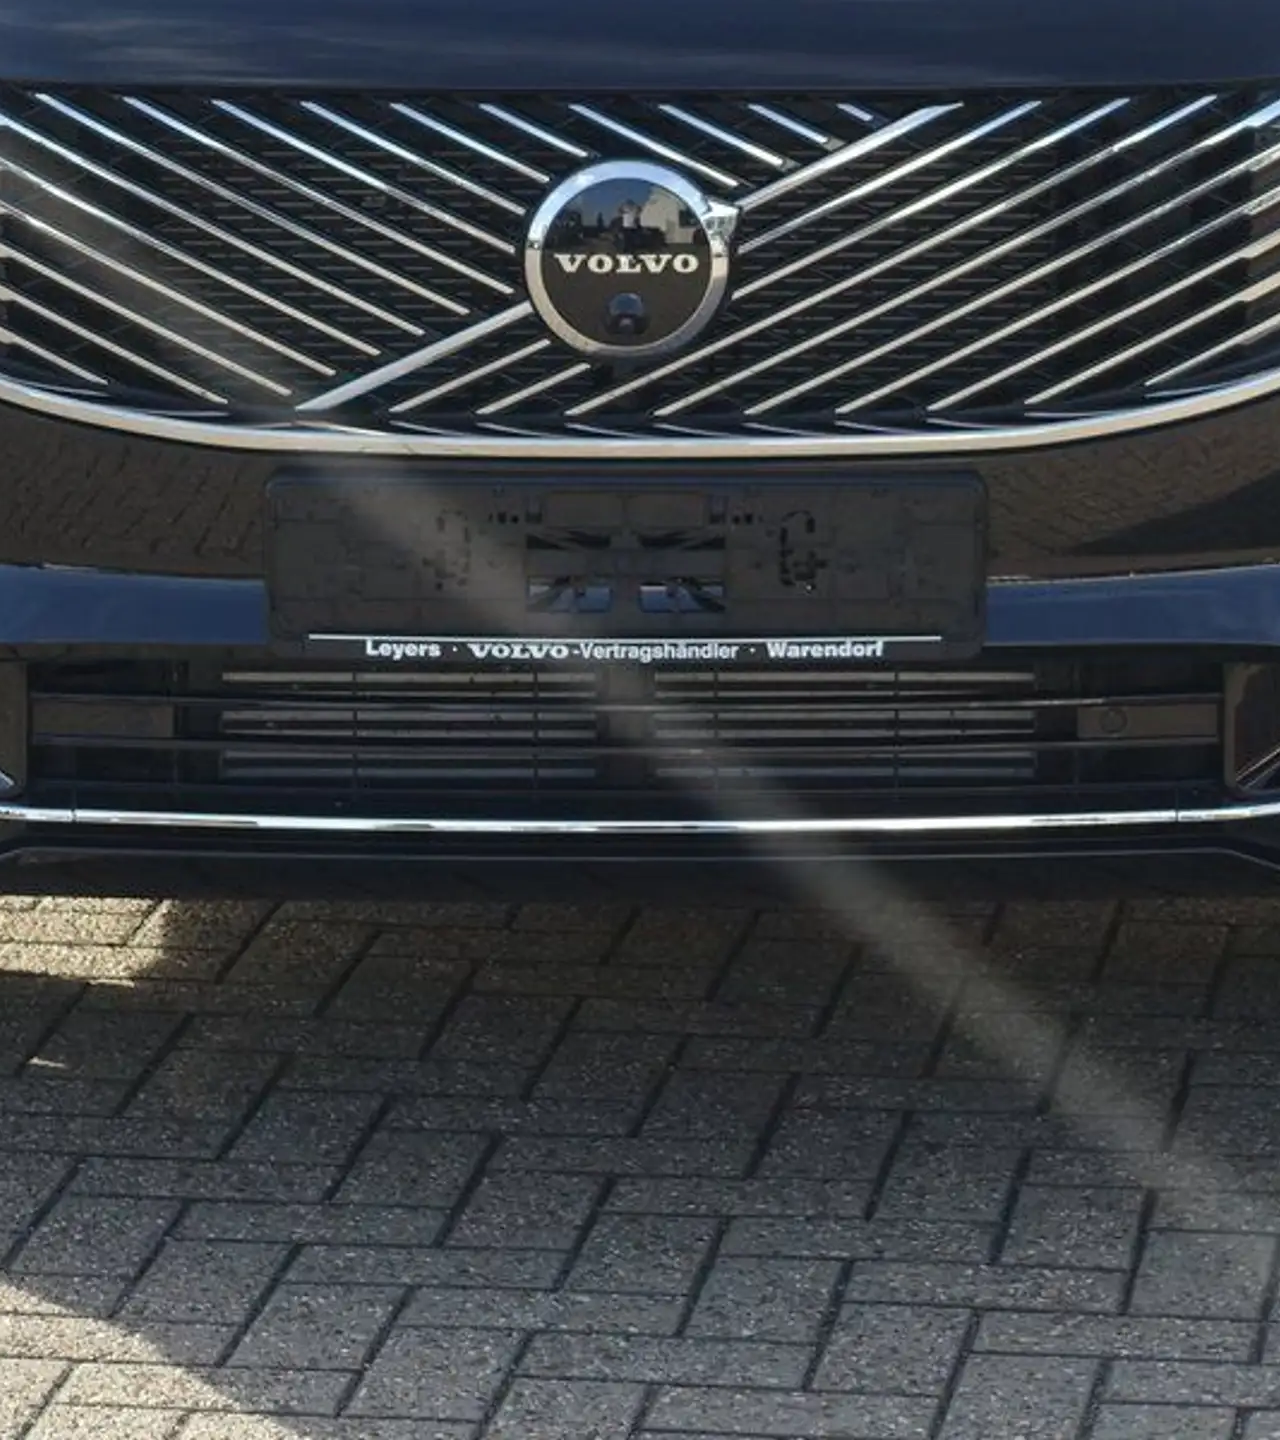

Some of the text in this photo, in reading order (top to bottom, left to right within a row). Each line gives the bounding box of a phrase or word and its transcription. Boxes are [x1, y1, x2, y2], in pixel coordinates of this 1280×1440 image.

[553, 253, 700, 275] VOLVO
[365, 638, 441, 661] Leyers
[767, 638, 884, 658] Warendorf
